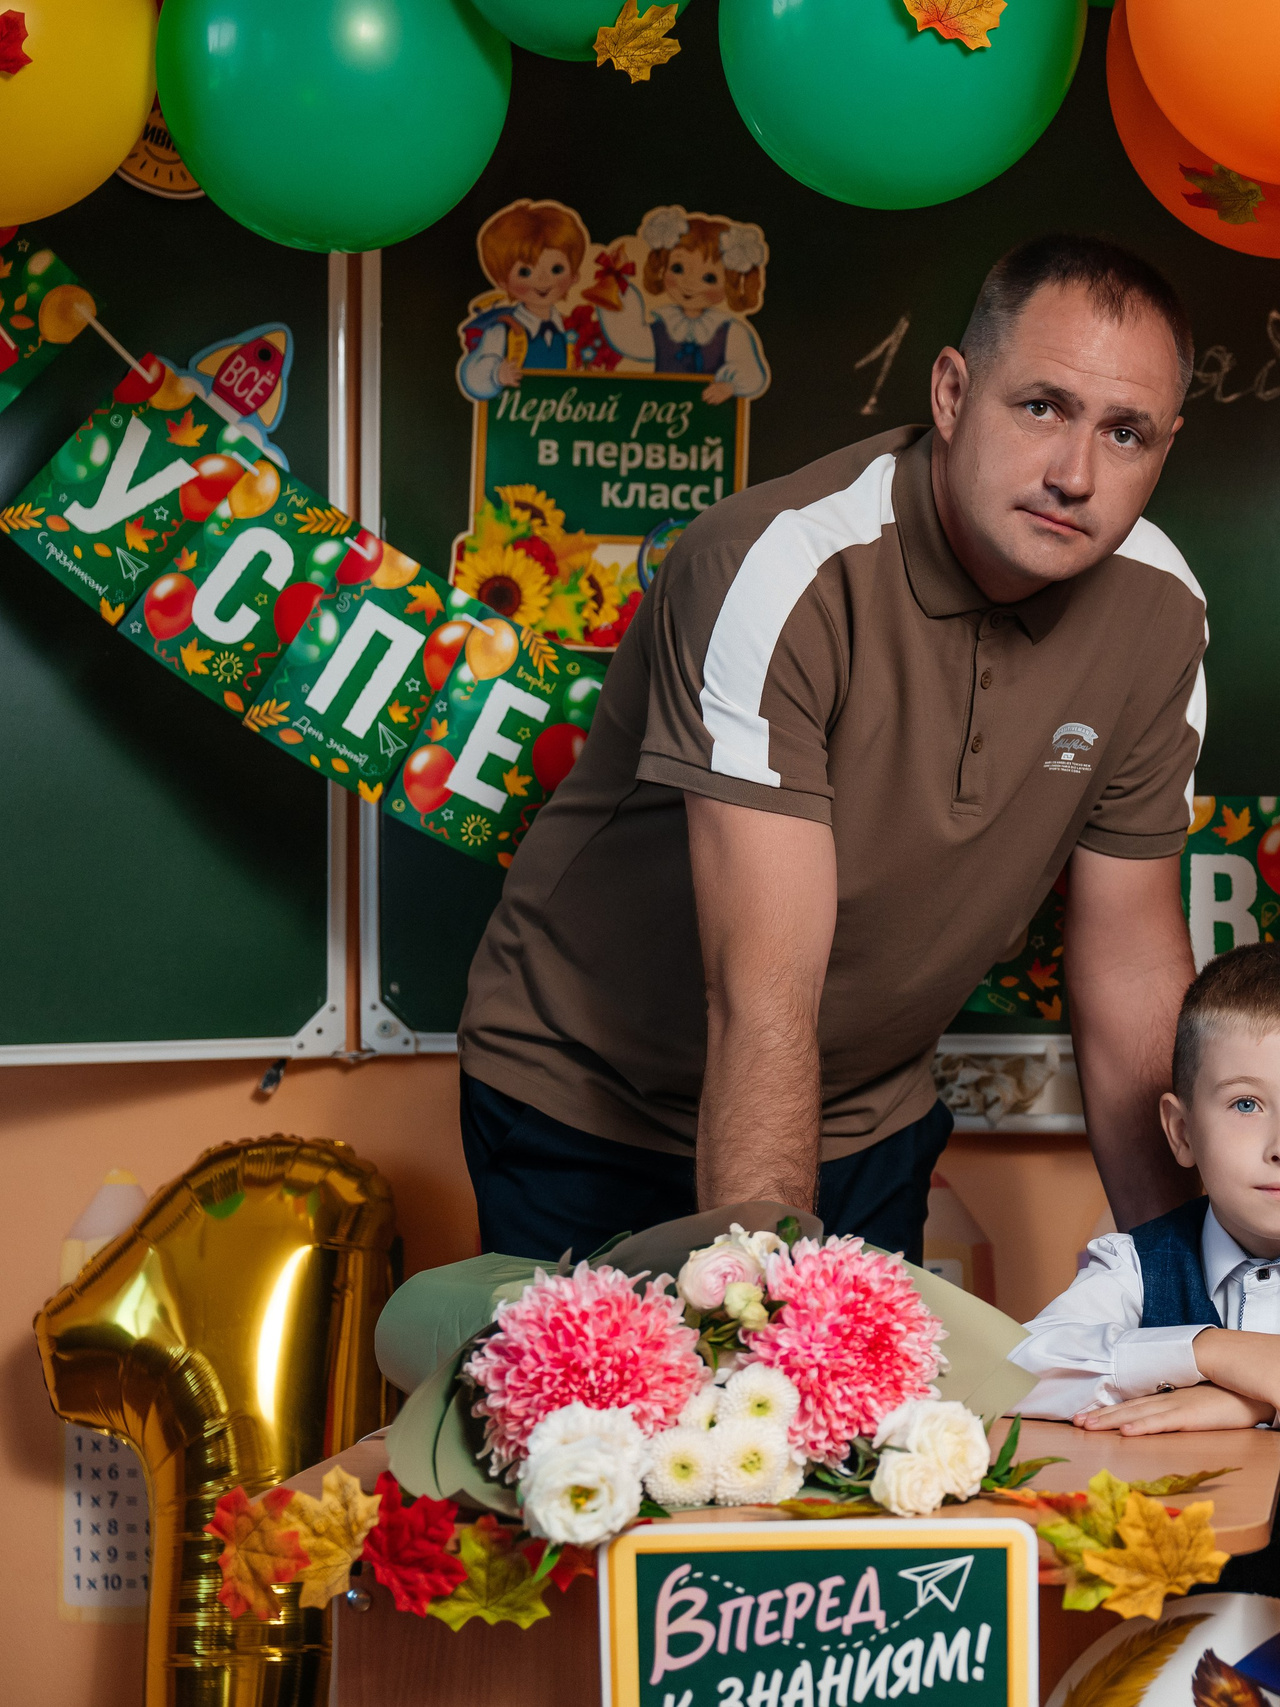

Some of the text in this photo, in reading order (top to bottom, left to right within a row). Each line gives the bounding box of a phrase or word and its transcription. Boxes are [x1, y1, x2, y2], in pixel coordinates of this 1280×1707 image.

[219, 354, 276, 409] ВСЁ
[496, 386, 693, 439] Первый раз
[538, 436, 725, 478] в первый
[601, 476, 725, 511] класс!
[292, 715, 324, 742] День
[108, 1435, 119, 1452] 5
[107, 1463, 120, 1481] 6
[107, 1490, 120, 1508] 7
[107, 1518, 119, 1536] 8
[107, 1546, 119, 1564] 9
[103, 1573, 122, 1591] 10
[649, 1563, 887, 1686] ВПЕРЕД
[717, 1622, 992, 1707] ЗНАНИЯМ!
